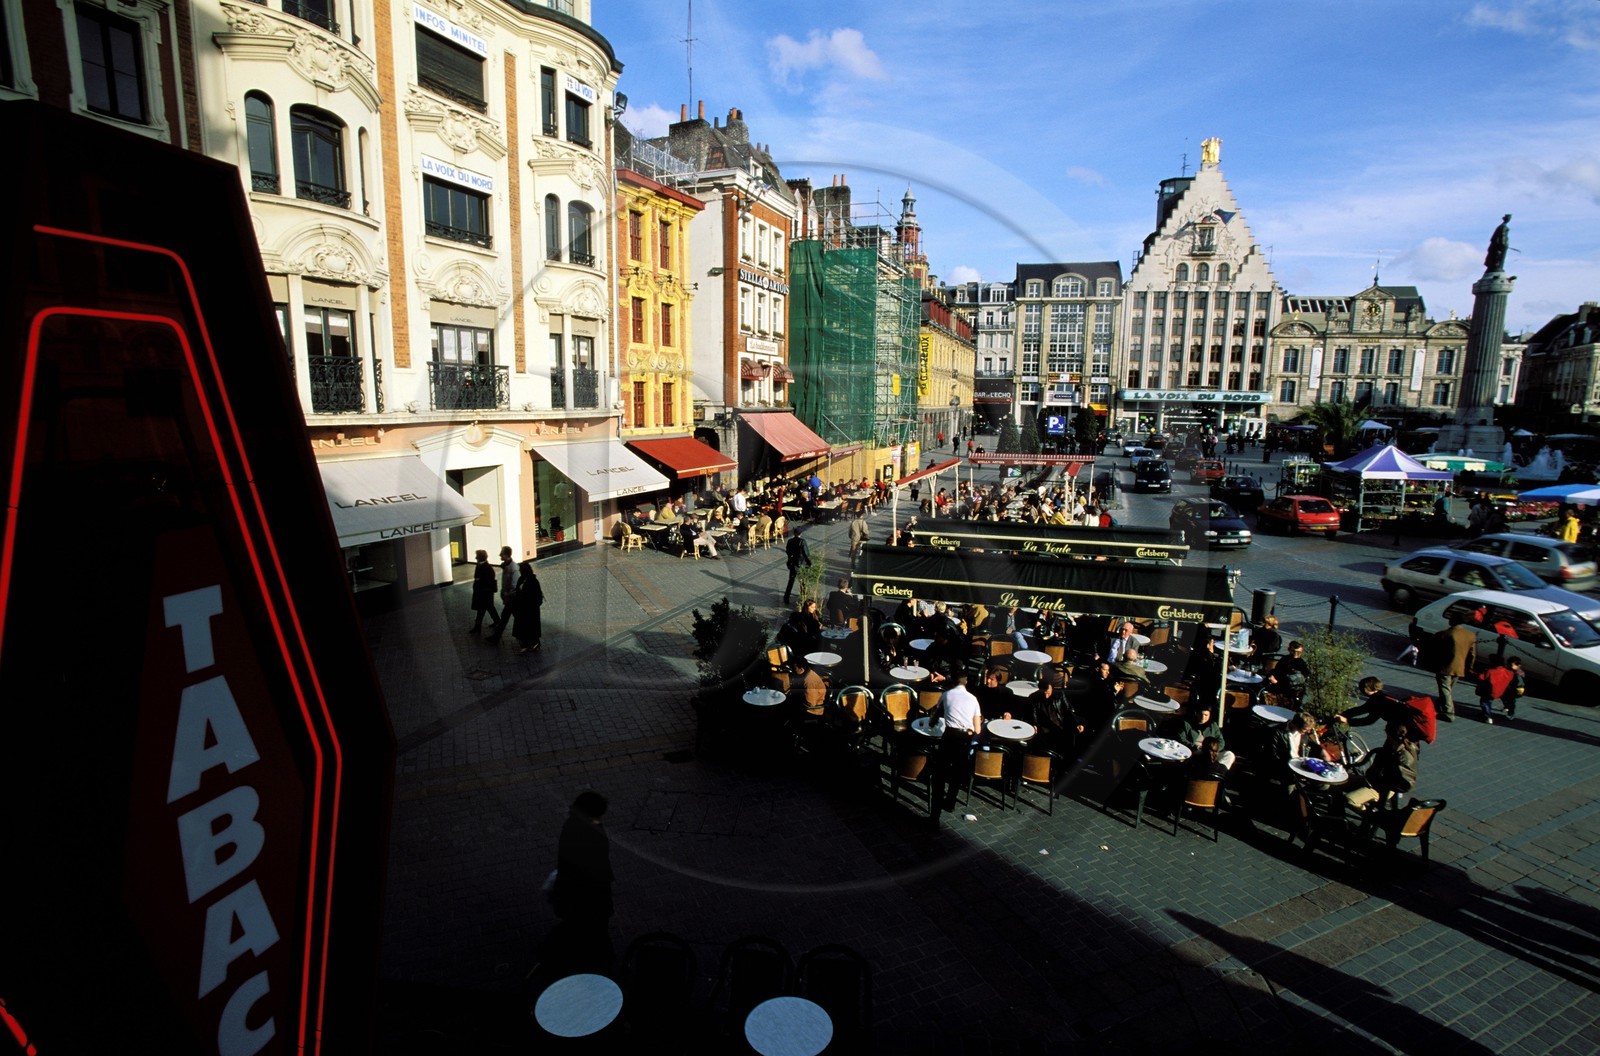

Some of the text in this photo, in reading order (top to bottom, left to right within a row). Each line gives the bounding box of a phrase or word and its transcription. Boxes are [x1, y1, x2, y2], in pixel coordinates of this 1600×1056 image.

[415, 7, 487, 54] INFOS MINITEL
[574, 81, 581, 93] LA
[582, 85, 593, 99] VOIX
[421, 158, 493, 191] LA VOIX DU NORD
[740, 269, 790, 296] STELLA ARTOIS
[311, 296, 347, 306] LANCEL
[449, 316, 475, 324] LANCEL
[1156, 392, 1190, 400] VOIX
[1198, 393, 1216, 401] DU
[1049, 416, 1059, 429] P
[586, 466, 635, 476] LANCEL
[616, 485, 647, 497] LANCEL
[334, 493, 428, 509] LANCEL
[380, 522, 439, 539] LANCEL
[930, 536, 960, 548] Carlsberg
[1022, 540, 1038, 551] La
[1136, 547, 1169, 559] Carlsberg
[873, 582, 913, 598] Carlsberg
[998, 592, 1020, 607] La
[1157, 605, 1205, 622] Carlsberg
[163, 584, 280, 1056] TABAC
